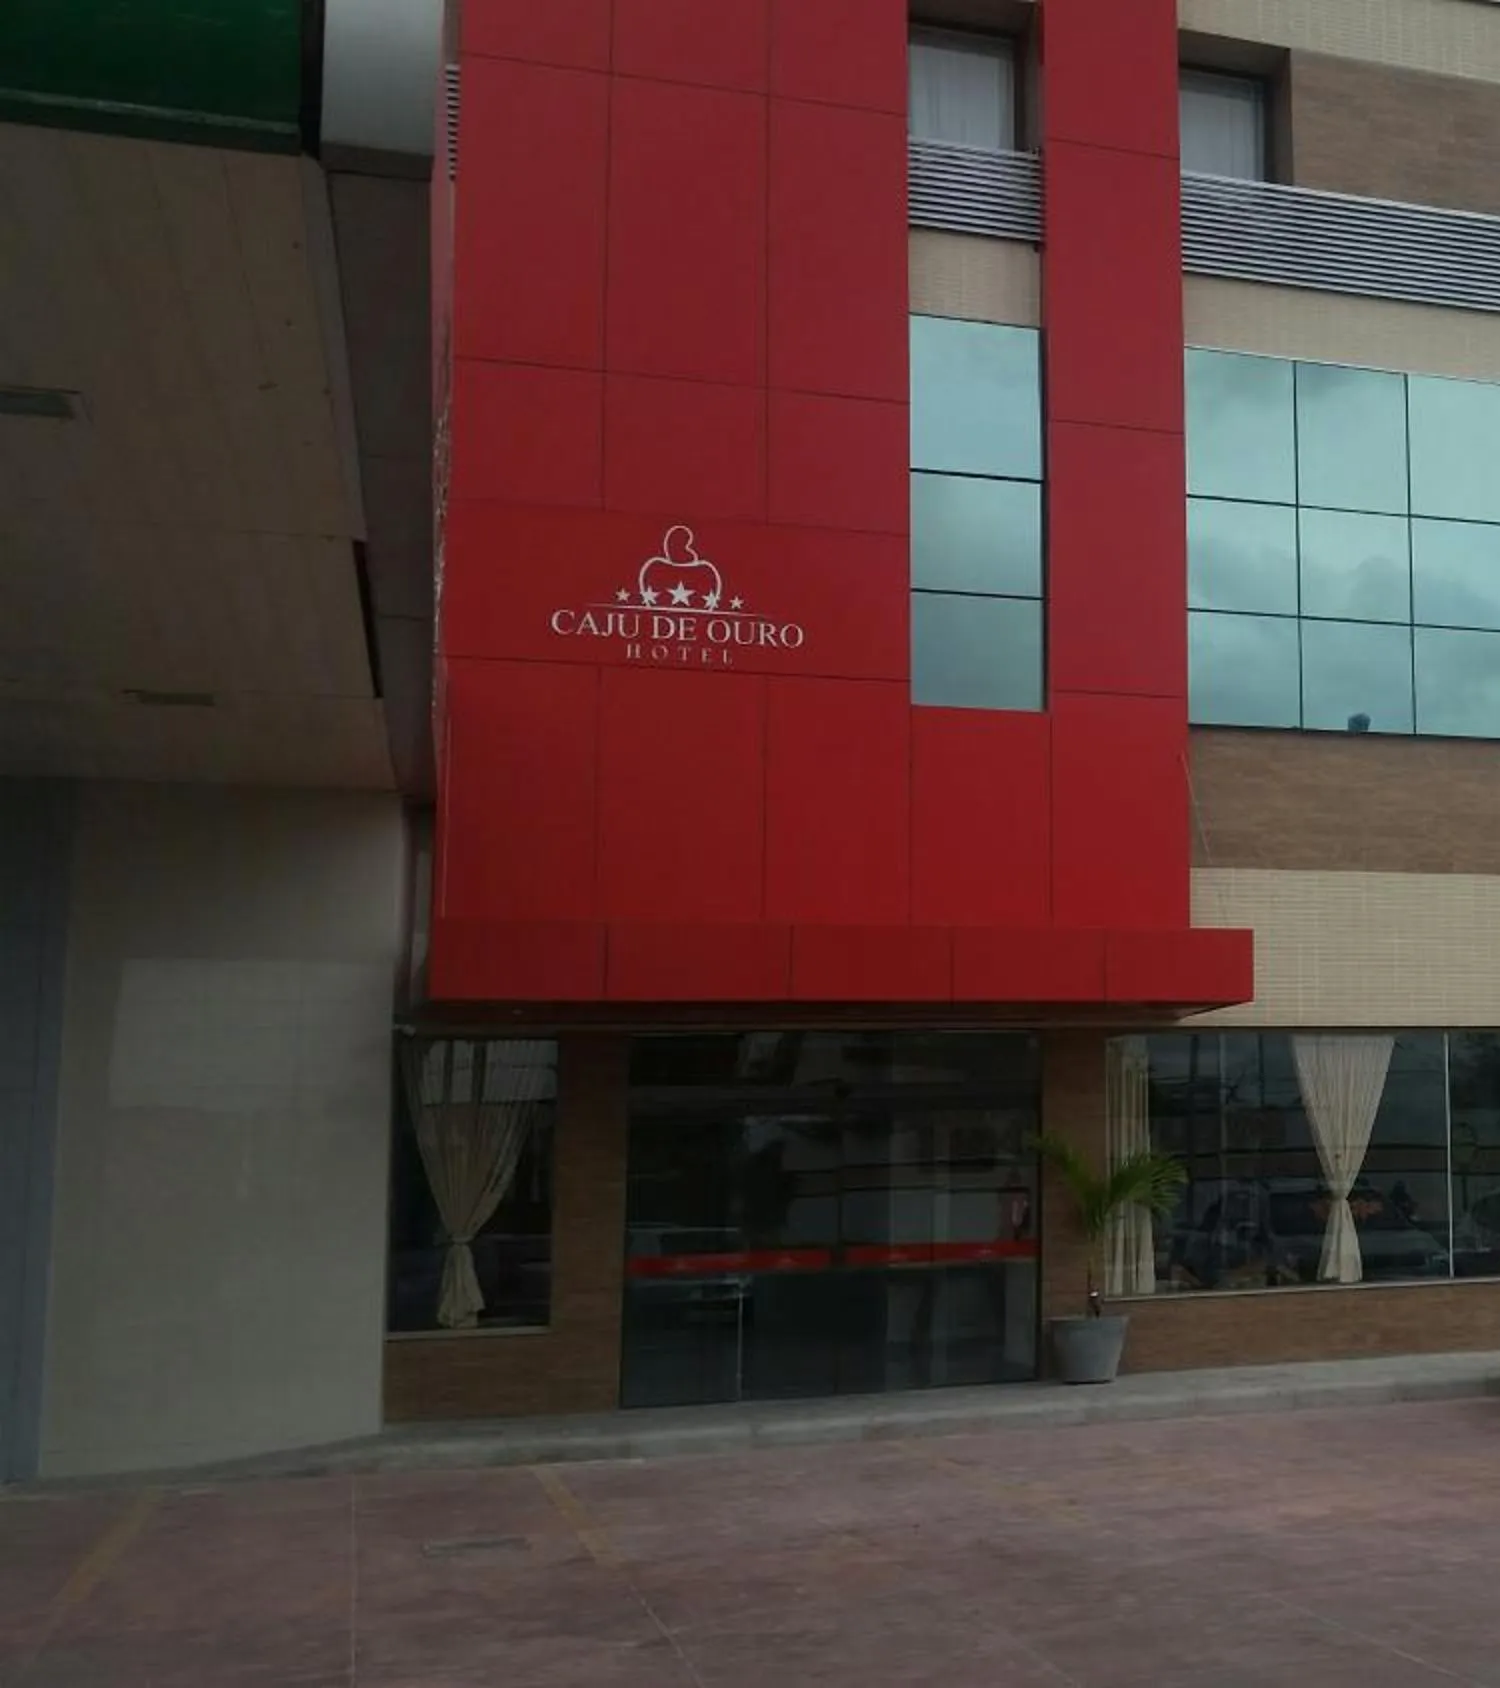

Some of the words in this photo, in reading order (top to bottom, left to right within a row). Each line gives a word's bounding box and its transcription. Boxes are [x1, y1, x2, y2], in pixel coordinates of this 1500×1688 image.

[551, 609, 640, 639] CAJU
[651, 615, 697, 642] DE
[707, 619, 804, 649] OURO
[626, 643, 734, 665] HOTEL
